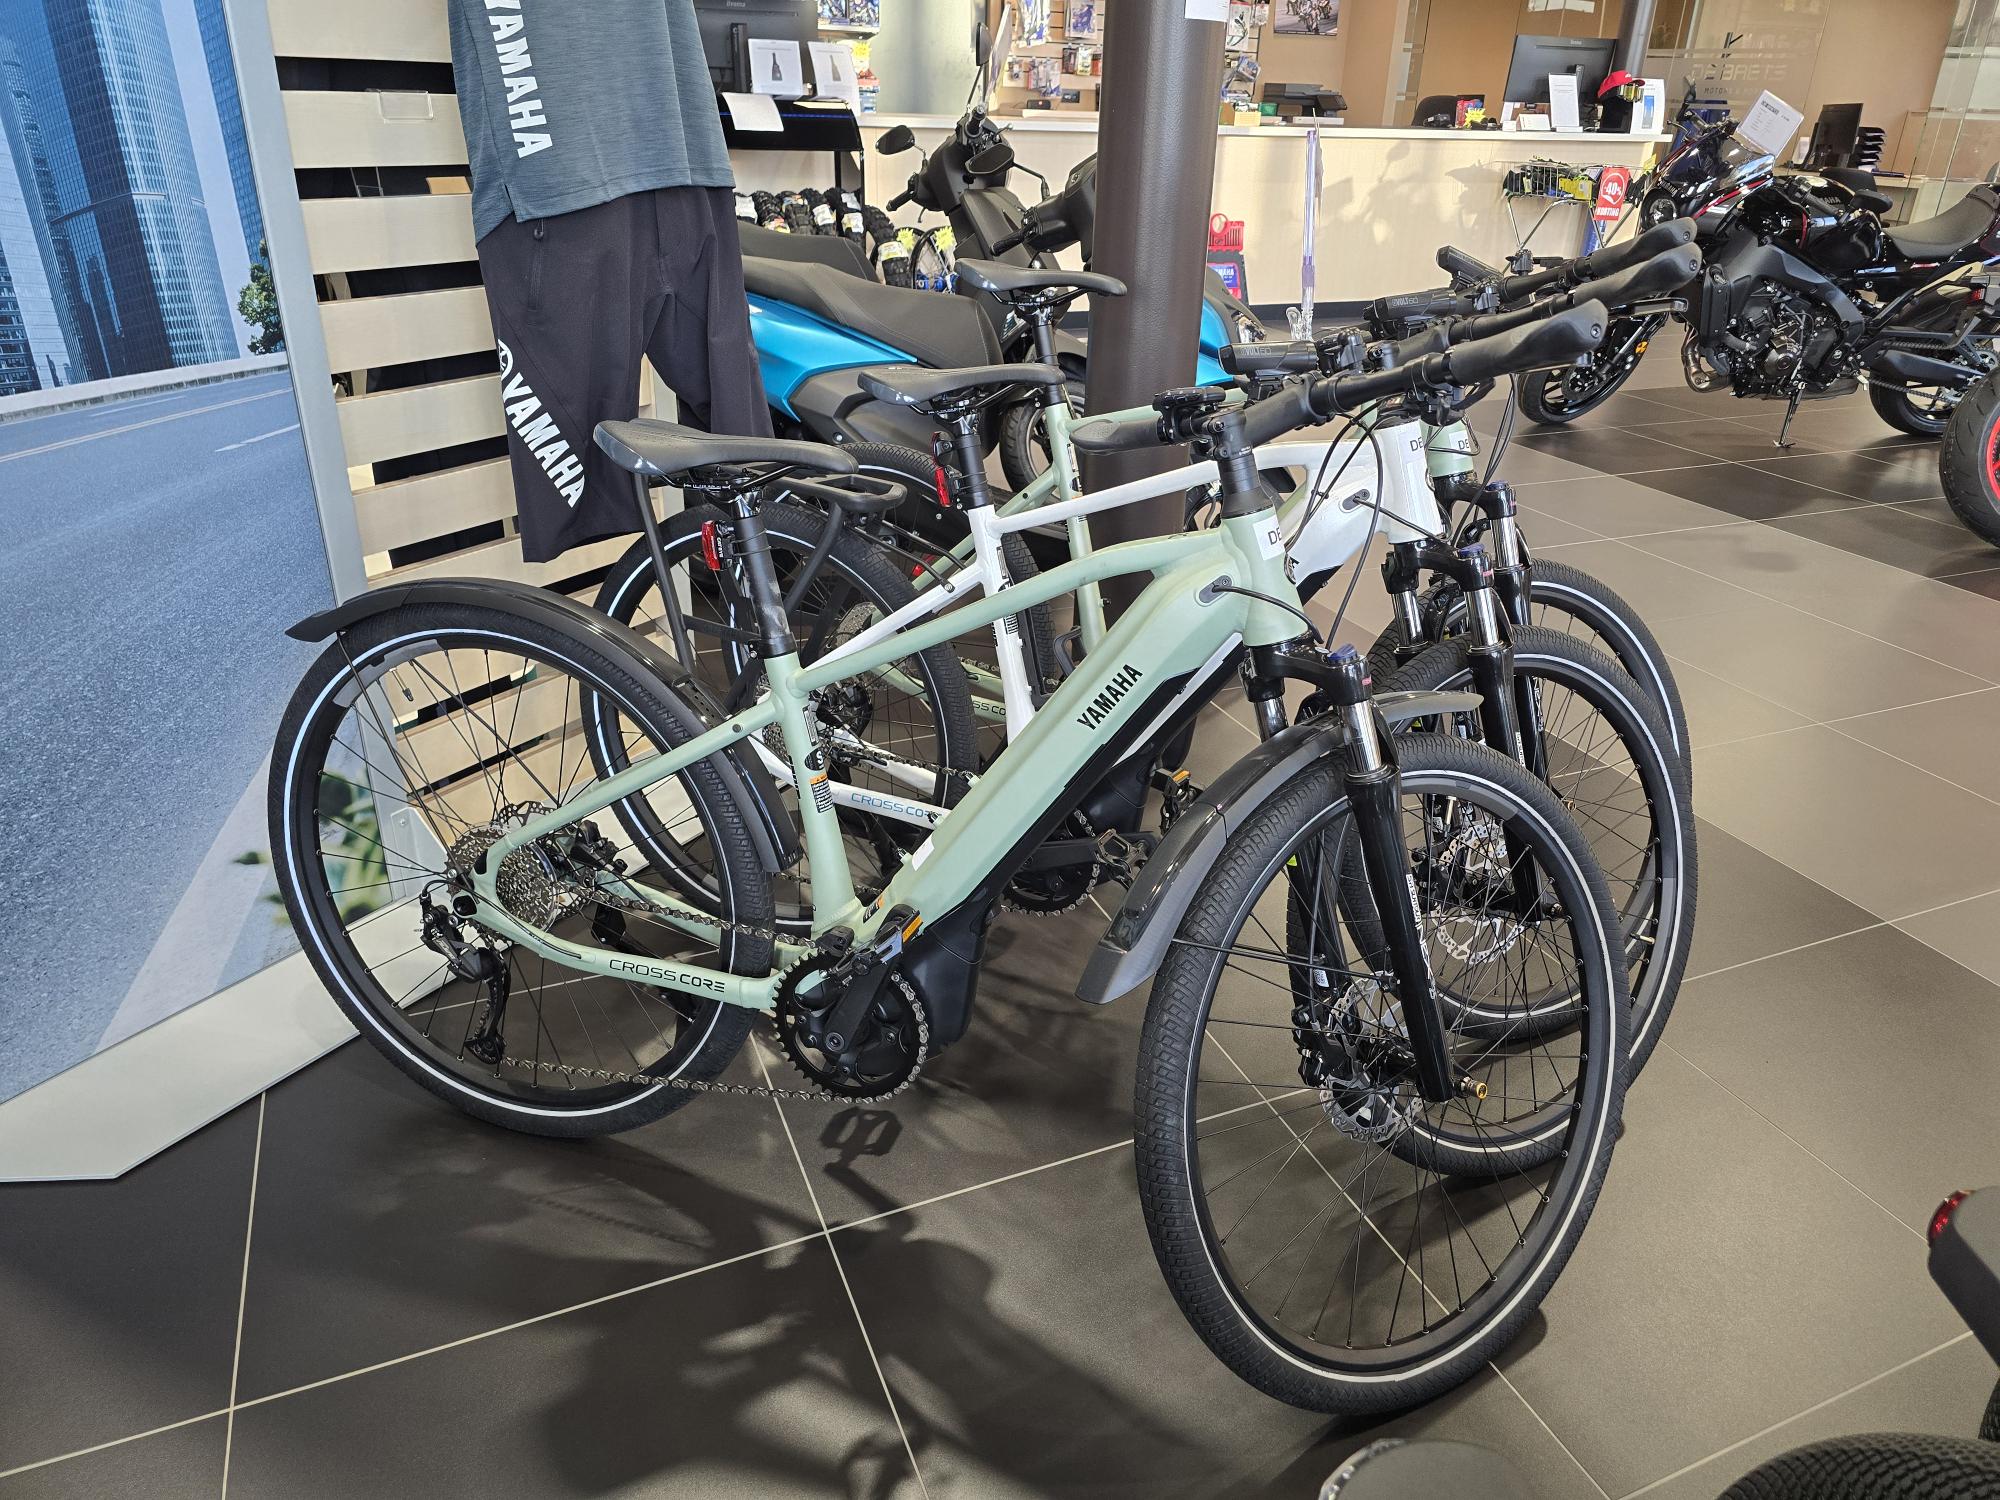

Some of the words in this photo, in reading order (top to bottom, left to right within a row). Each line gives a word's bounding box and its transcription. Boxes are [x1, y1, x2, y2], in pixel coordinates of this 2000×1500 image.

[502, 372, 586, 508] YAMAHA
[1077, 664, 1144, 731] YAMAHA
[851, 792, 904, 813] CROSS
[609, 959, 676, 982] CROSS
[679, 973, 725, 993] CORE
